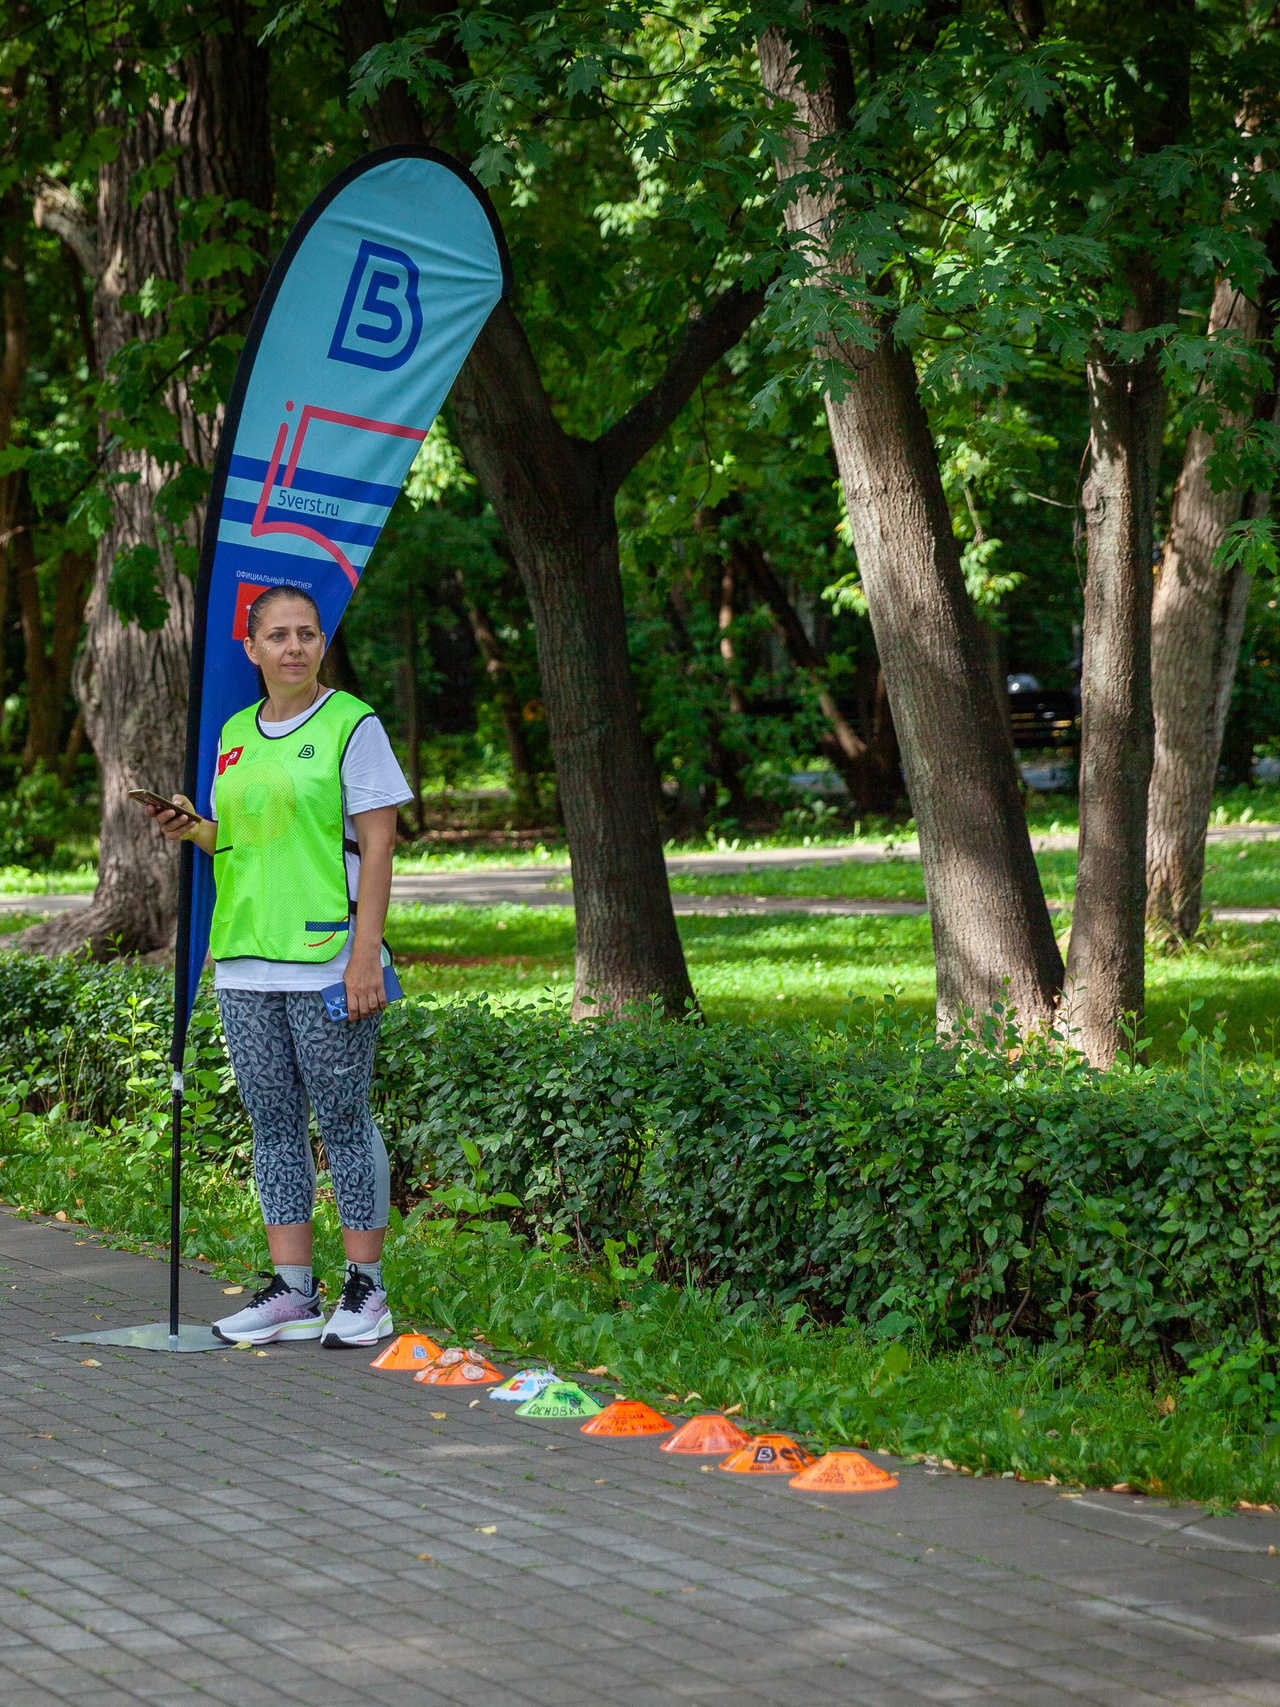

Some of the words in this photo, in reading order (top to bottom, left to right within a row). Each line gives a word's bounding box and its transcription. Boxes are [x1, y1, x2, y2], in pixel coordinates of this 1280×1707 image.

[277, 489, 340, 516] 5verst.ru
[236, 570, 285, 585] ОФИЦИАЛЬНЫЙ
[285, 579, 313, 590] ПАРТНЕР
[528, 1404, 586, 1417] СОСНОВКА
